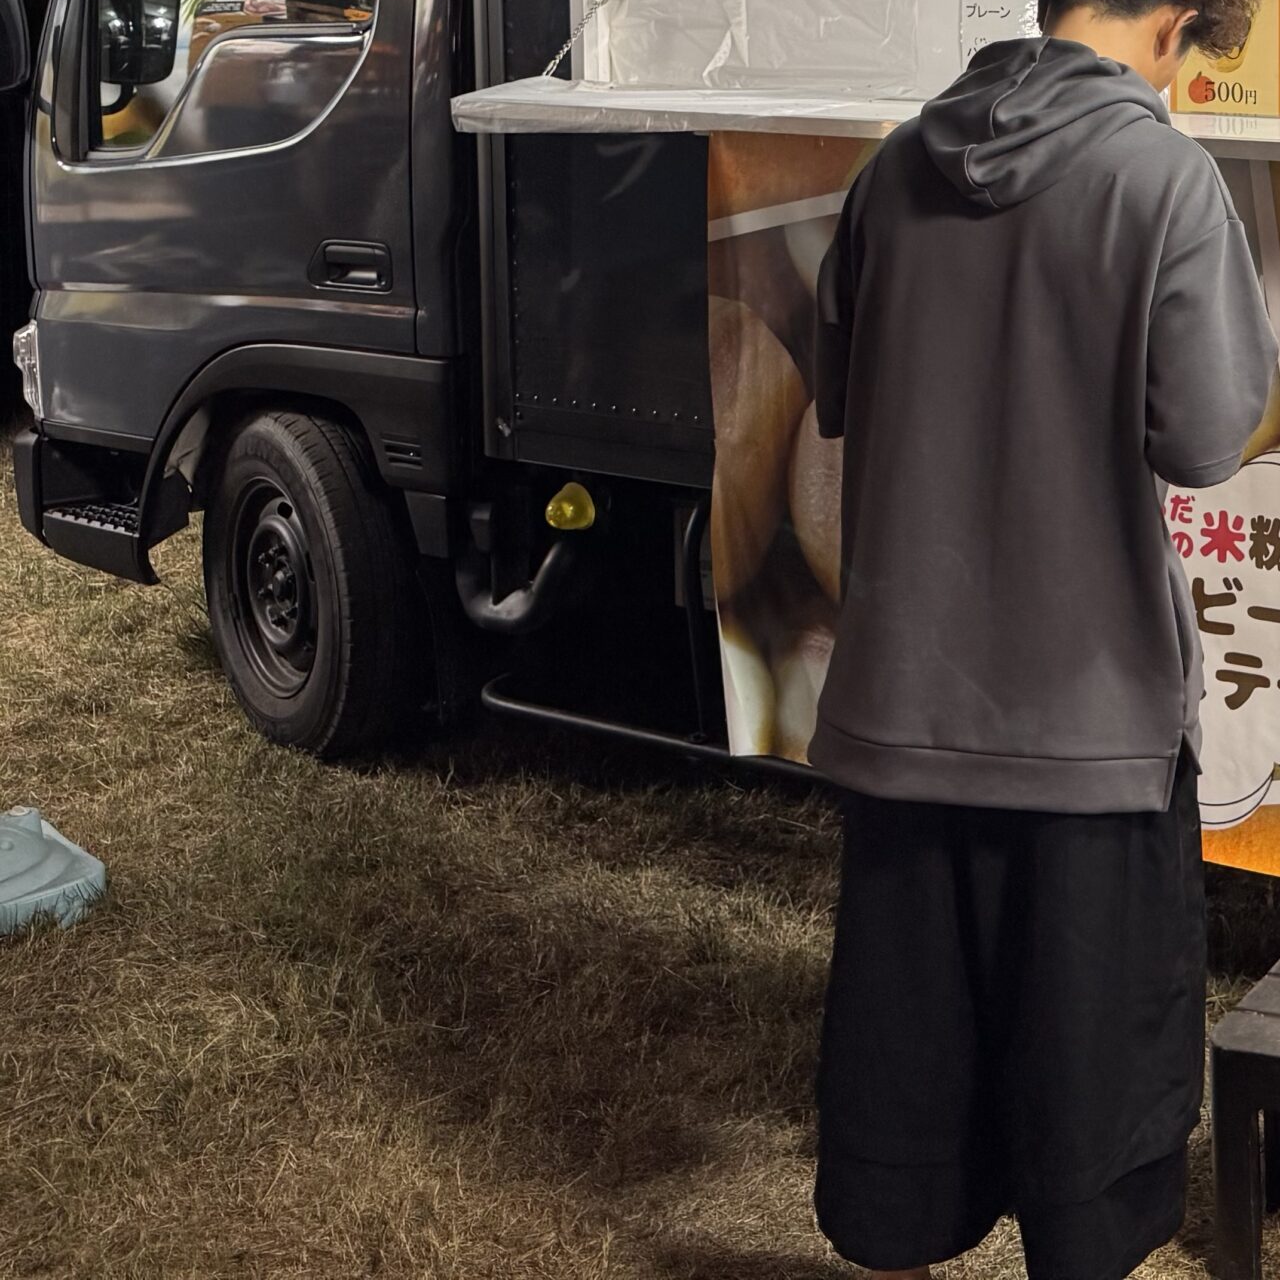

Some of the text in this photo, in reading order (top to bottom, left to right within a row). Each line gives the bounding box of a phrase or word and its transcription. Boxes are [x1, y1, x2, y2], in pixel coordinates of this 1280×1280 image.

[966, 2, 1011, 18] プレーン
[1204, 81, 1257, 105] 500円
[1162, 494, 1196, 524] だ
